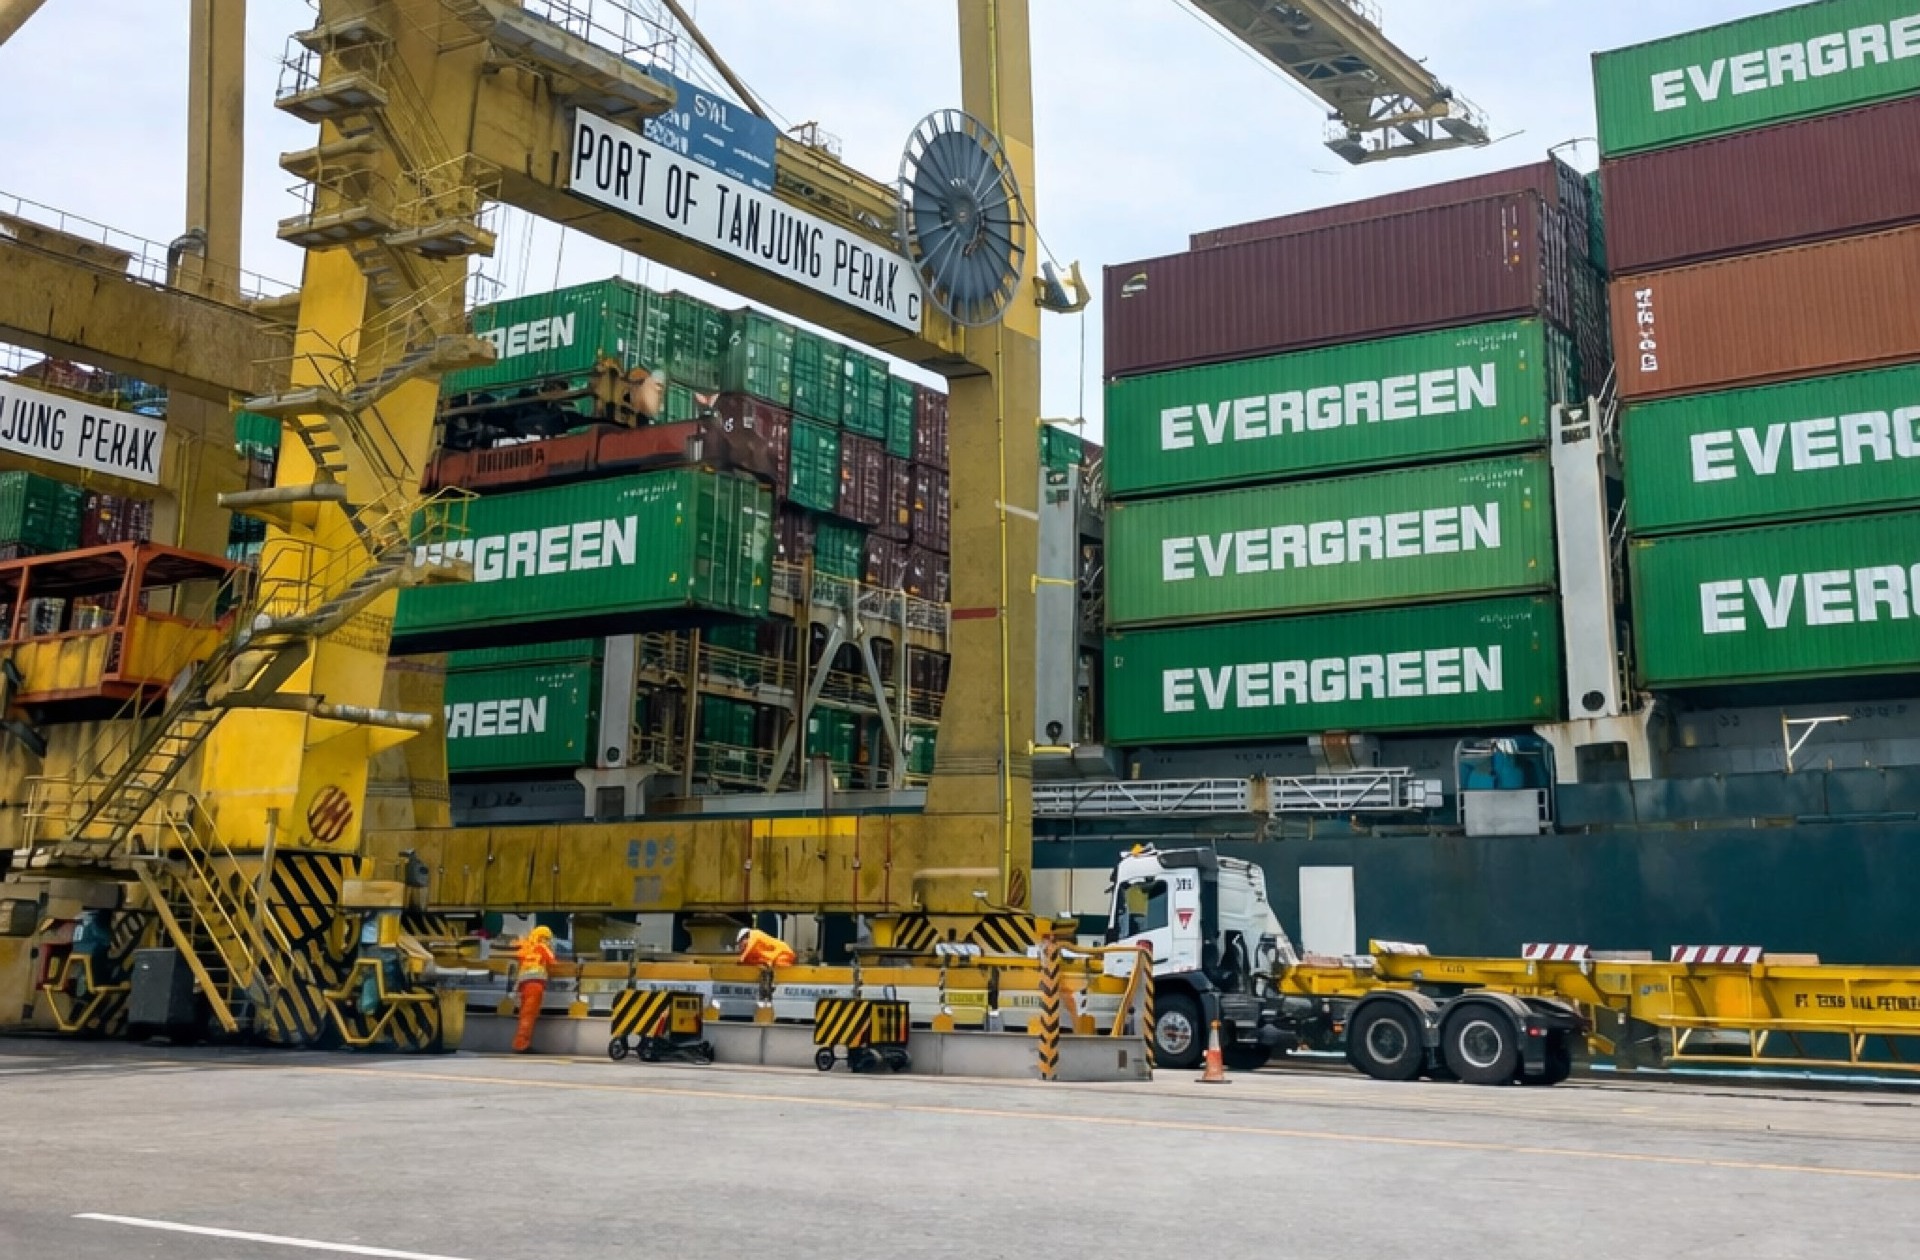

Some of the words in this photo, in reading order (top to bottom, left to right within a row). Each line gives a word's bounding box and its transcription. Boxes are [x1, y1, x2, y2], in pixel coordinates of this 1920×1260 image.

[1651, 13, 1920, 112] EVERGRE
[575, 123, 652, 206] PORT
[665, 164, 700, 225] OF
[716, 183, 824, 278] TANJUNG
[832, 238, 899, 313] PERAK
[0, 396, 67, 451] JUNG
[78, 414, 157, 473] PERAK
[1161, 362, 1497, 451] EVERGREEN
[1162, 502, 1501, 582] EVERGREEN
[1700, 563, 1920, 635] EVER
[445, 696, 547, 738] REEN
[1163, 645, 1503, 713] EVERGREEN
